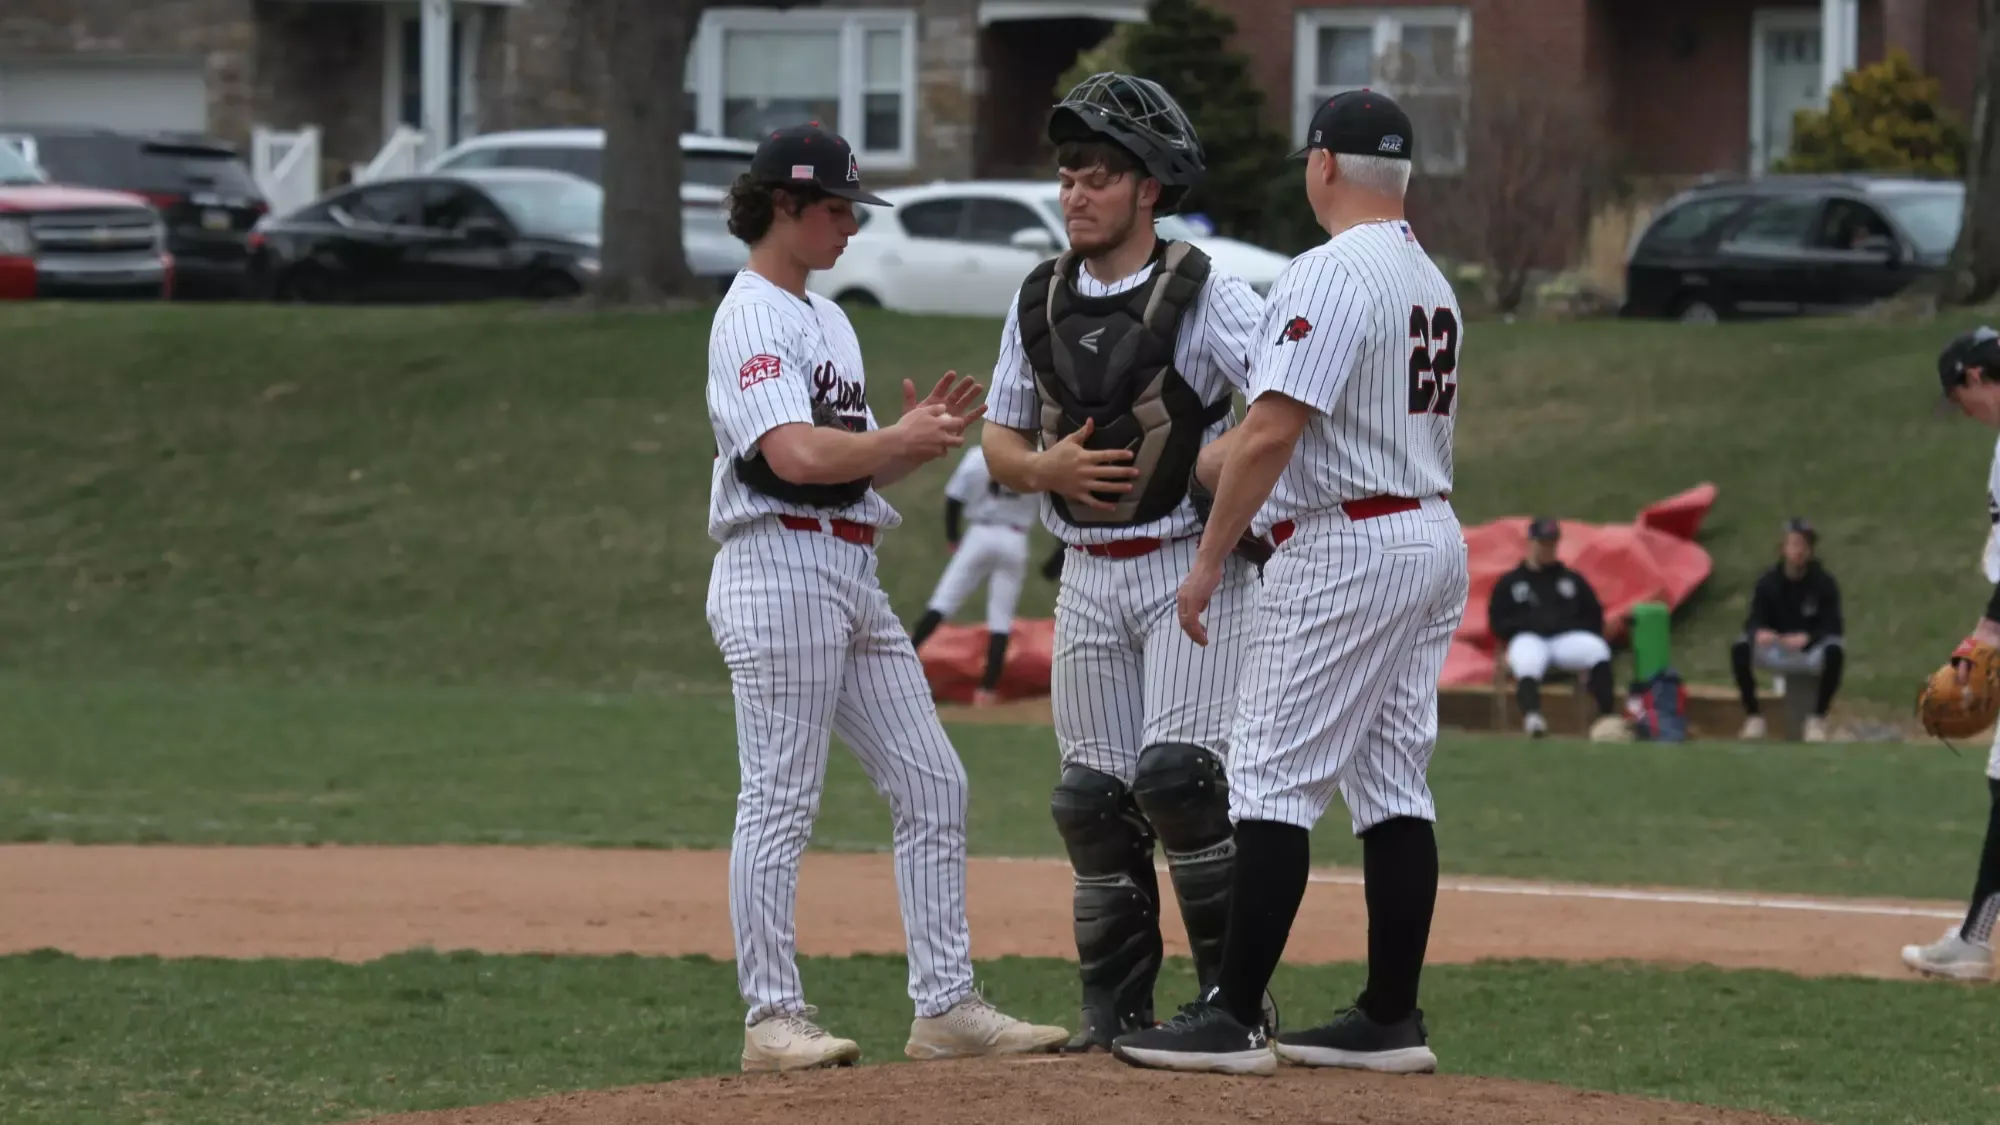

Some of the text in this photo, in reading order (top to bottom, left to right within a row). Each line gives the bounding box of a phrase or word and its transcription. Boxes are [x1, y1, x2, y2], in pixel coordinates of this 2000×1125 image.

[1381, 141, 1401, 151] MAC
[741, 365, 779, 389] MAC
[1408, 304, 1457, 416] 22
[813, 359, 867, 413] Lion
